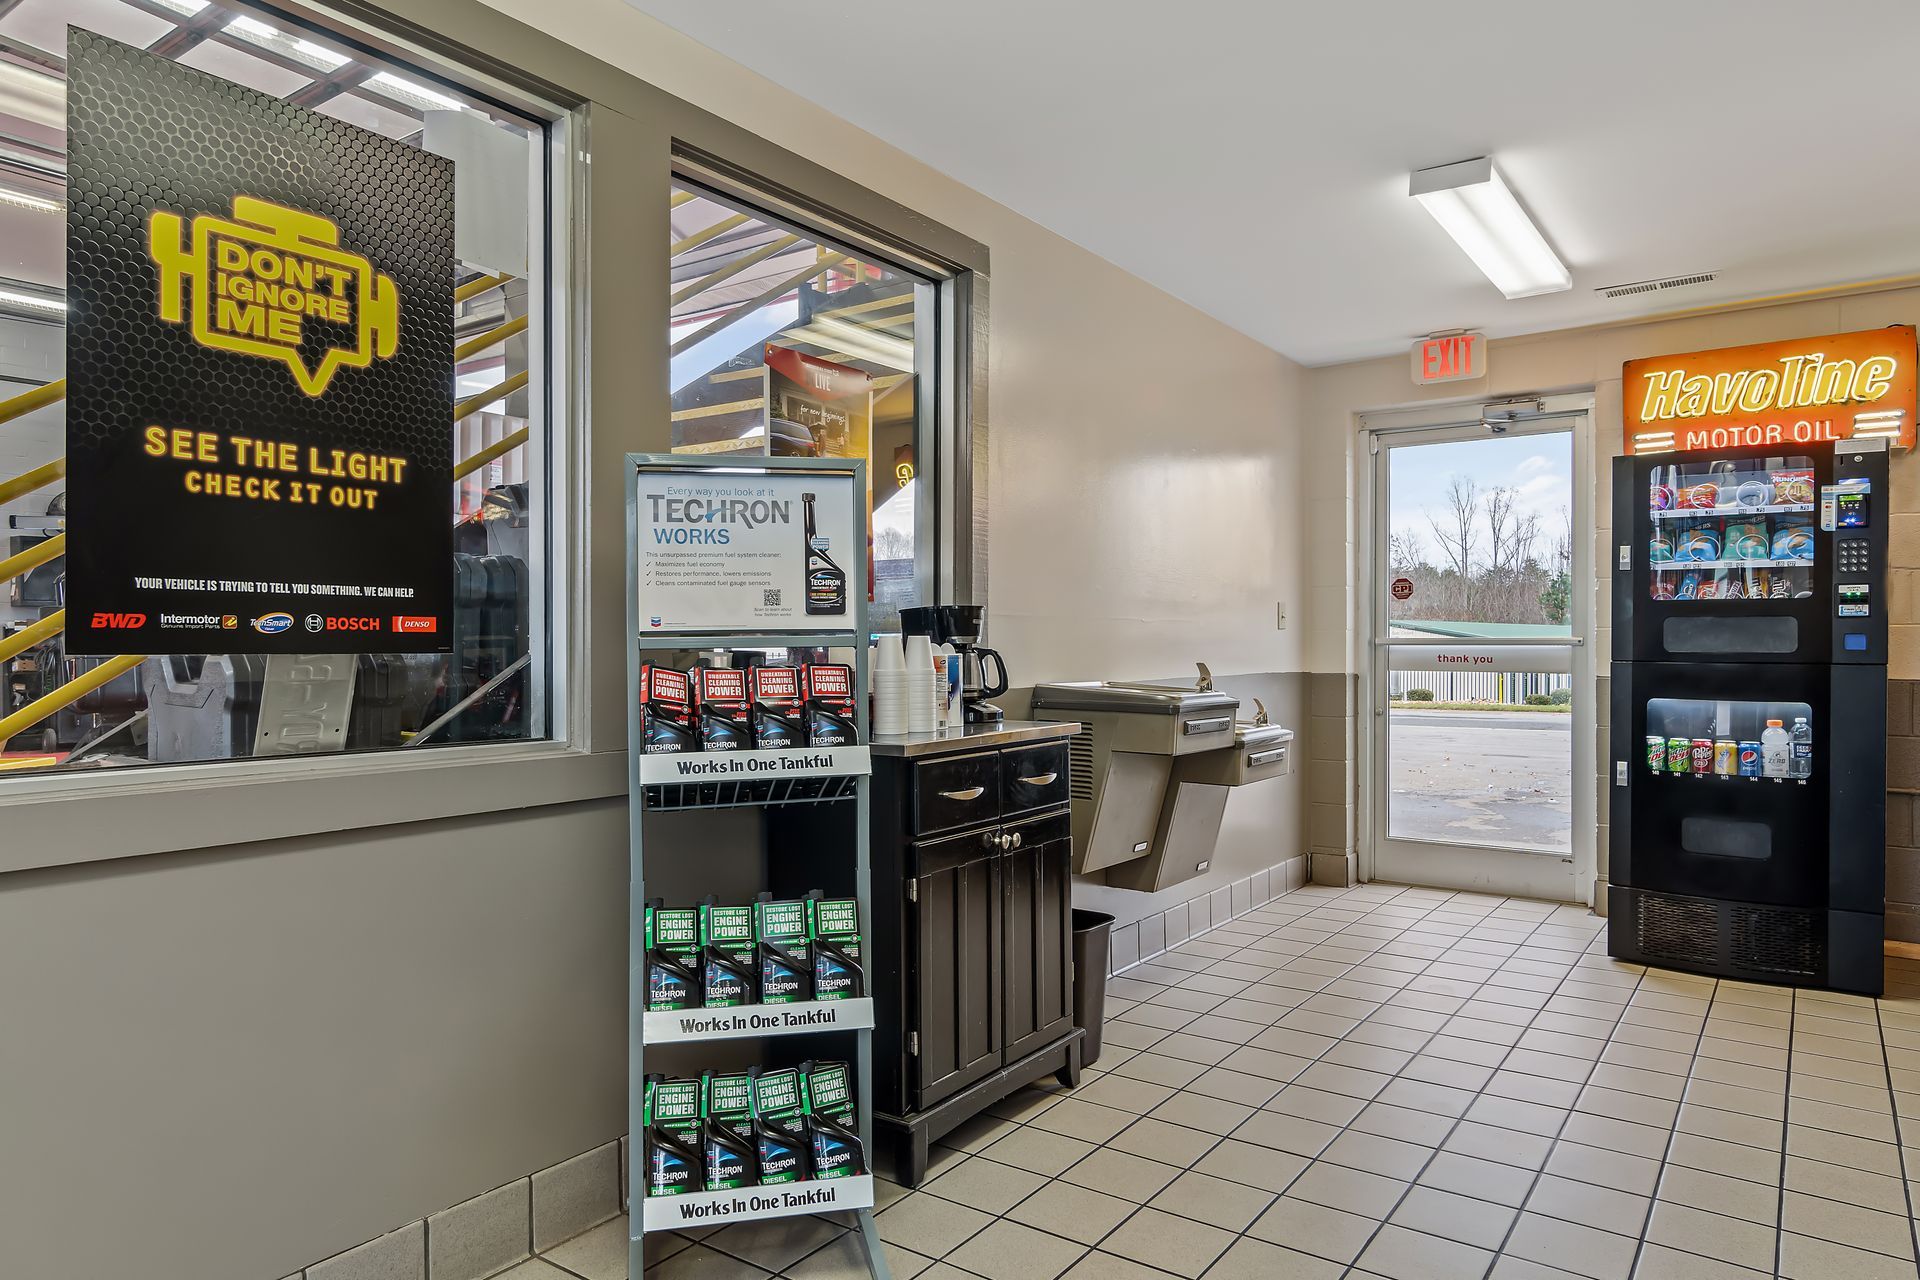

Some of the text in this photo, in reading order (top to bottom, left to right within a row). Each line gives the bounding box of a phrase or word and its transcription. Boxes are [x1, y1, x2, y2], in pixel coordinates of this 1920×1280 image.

[217, 239, 351, 297] DON'T
[217, 272, 349, 323] IGNORE
[217, 298, 301, 345] ME
[1423, 336, 1476, 379] EXIT
[1640, 352, 1898, 424] Havoline
[800, 404, 808, 414] for
[1686, 420, 1841, 450] MOTOR OIL
[144, 426, 407, 484] SEE THE LIGHT
[184, 470, 378, 510] CHECK IT OUT
[667, 487, 774, 498] Every way you look at it
[647, 494, 790, 529] TECHRON
[653, 528, 730, 545] WORKS
[135, 577, 162, 589] YOUR
[164, 578, 205, 591] VEHICLE
[207, 580, 217, 591] IS
[219, 580, 254, 592] TRYING
[256, 582, 268, 593] TO
[270, 582, 290, 594] TELL
[292, 583, 309, 594] YOU
[311, 584, 362, 596] SOMETHING.
[364, 586, 376, 597] WE
[378, 587, 393, 598] CAN
[811, 579, 841, 587] TECHRON
[91, 612, 147, 629] BWD
[161, 613, 220, 624] Intermotor
[326, 617, 380, 631] BOSCH
[1437, 654, 1493, 665] thank you
[656, 679, 684, 689] CLEANING
[762, 684, 794, 694] POWER
[816, 683, 847, 692] POWER
[655, 686, 685, 699] POWER
[709, 686, 742, 696] POWER
[704, 741, 737, 750] TECHRON
[758, 739, 791, 747] TECHRON
[812, 736, 844, 745] TECHRON
[647, 743, 681, 752] TECHRON
[677, 754, 833, 774] Works In One Tankful
[766, 912, 801, 923] ENGINE
[821, 910, 853, 920] ENGINE
[660, 920, 693, 929] ENGINE
[714, 916, 748, 926] ENGINE
[822, 920, 854, 931] POWER
[714, 926, 748, 937] POWER
[767, 922, 802, 934] POWER
[661, 930, 693, 940] POWER
[764, 982, 798, 991] TECHRON
[818, 979, 851, 987] TECHRON
[651, 990, 686, 998] TECHRON
[707, 986, 740, 995] TECHRON
[680, 1008, 836, 1034] Works In One Tankful
[760, 1082, 794, 1096] ENGINE
[814, 1078, 844, 1093] ENGINE
[715, 1086, 747, 1097] ENGINE
[816, 1088, 846, 1105] POWER
[659, 1093, 694, 1104] ENGINE
[715, 1097, 747, 1109] POWER
[761, 1093, 795, 1109] POWER
[658, 1104, 694, 1116] POWER
[762, 1158, 796, 1170] TECHRON
[817, 1153, 850, 1165] TECHRON
[653, 1171, 688, 1181] TECHRON
[708, 1166, 743, 1175] TECHRON
[818, 1170, 842, 1179] DIESEL
[763, 1176, 786, 1185] DIESEL
[652, 1188, 676, 1196] DIESEL
[680, 1187, 836, 1219] Works In One Tankful
